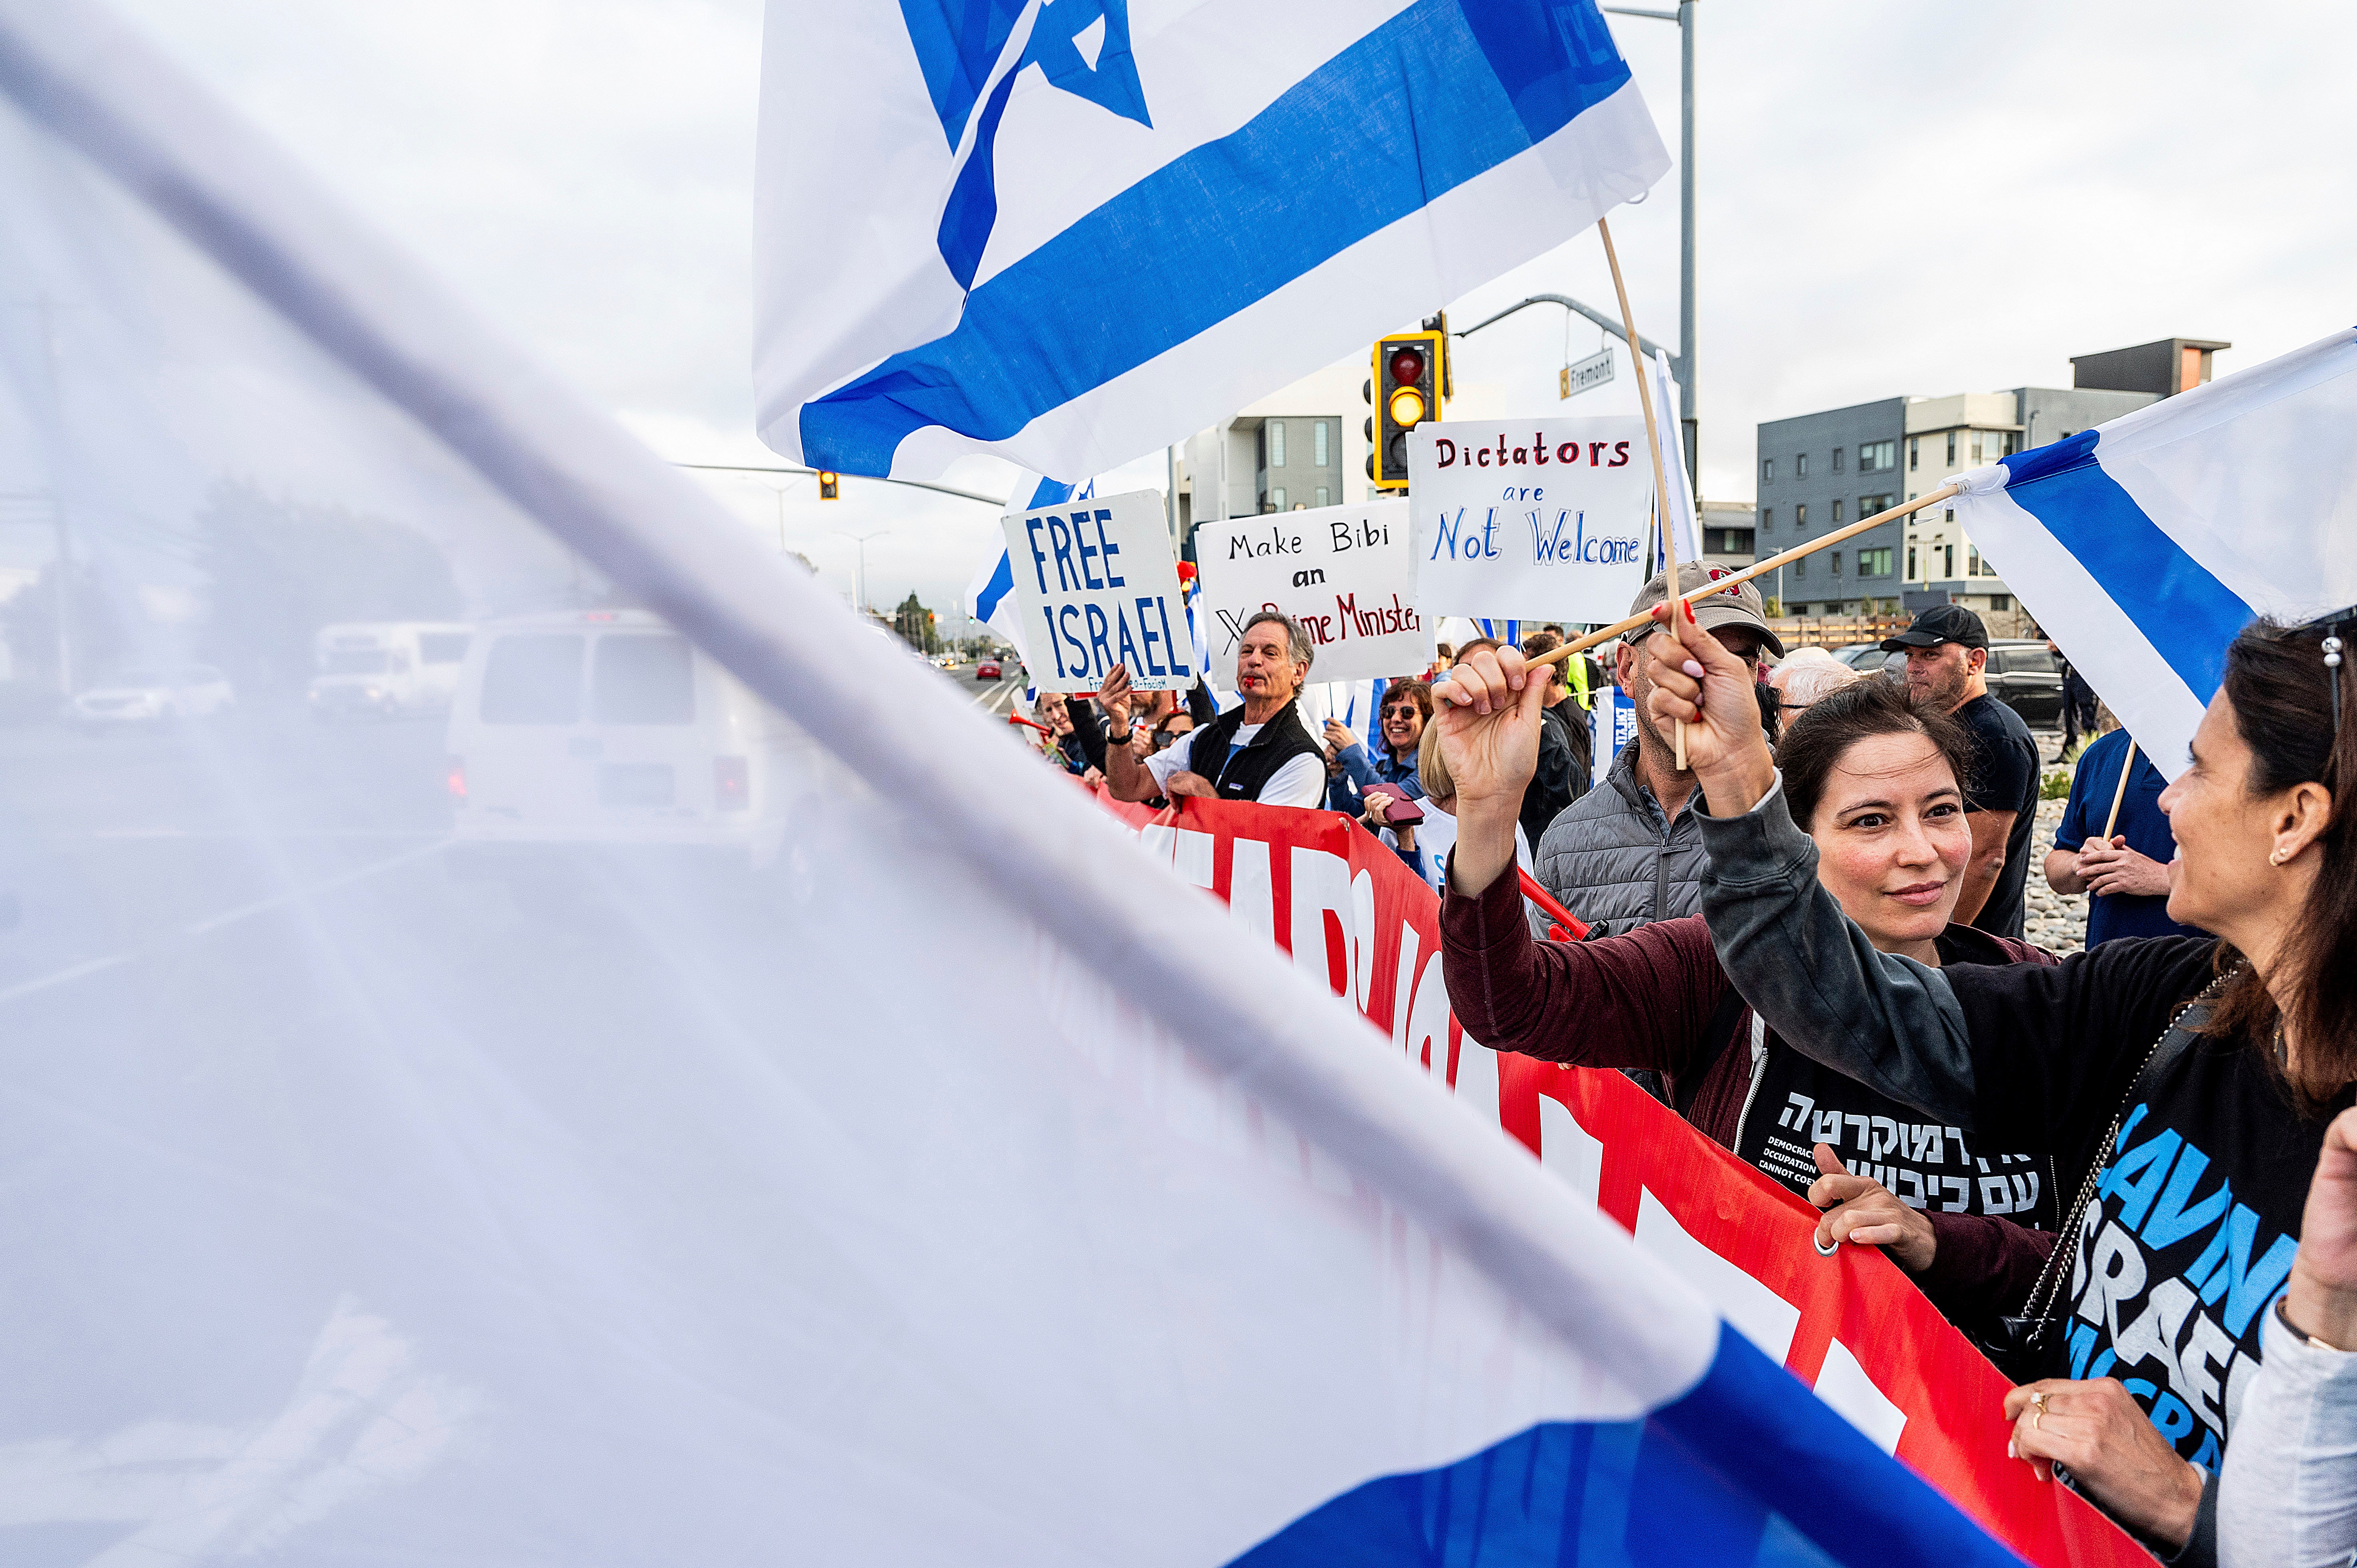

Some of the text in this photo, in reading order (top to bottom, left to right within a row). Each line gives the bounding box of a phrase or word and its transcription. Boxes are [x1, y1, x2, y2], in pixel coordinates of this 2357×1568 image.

[1570, 355, 1610, 390] Fremont
[1436, 432, 1630, 469] Dictators
[1503, 486, 1543, 501] are
[1025, 509, 1125, 594] FREE
[1229, 519, 1388, 559] Make Bibi
[1430, 505, 1641, 566] Not Welcome
[1293, 568, 1326, 588] an
[1043, 596, 1190, 678] ISRAEL
[1088, 677, 1103, 692] Fro
[1759, 1160, 1794, 1179] CANNOT
[1763, 1148, 1817, 1174] OCCUPATION
[1978, 1172, 2039, 1215] עם
[2096, 1102, 2300, 1351] AVIN
